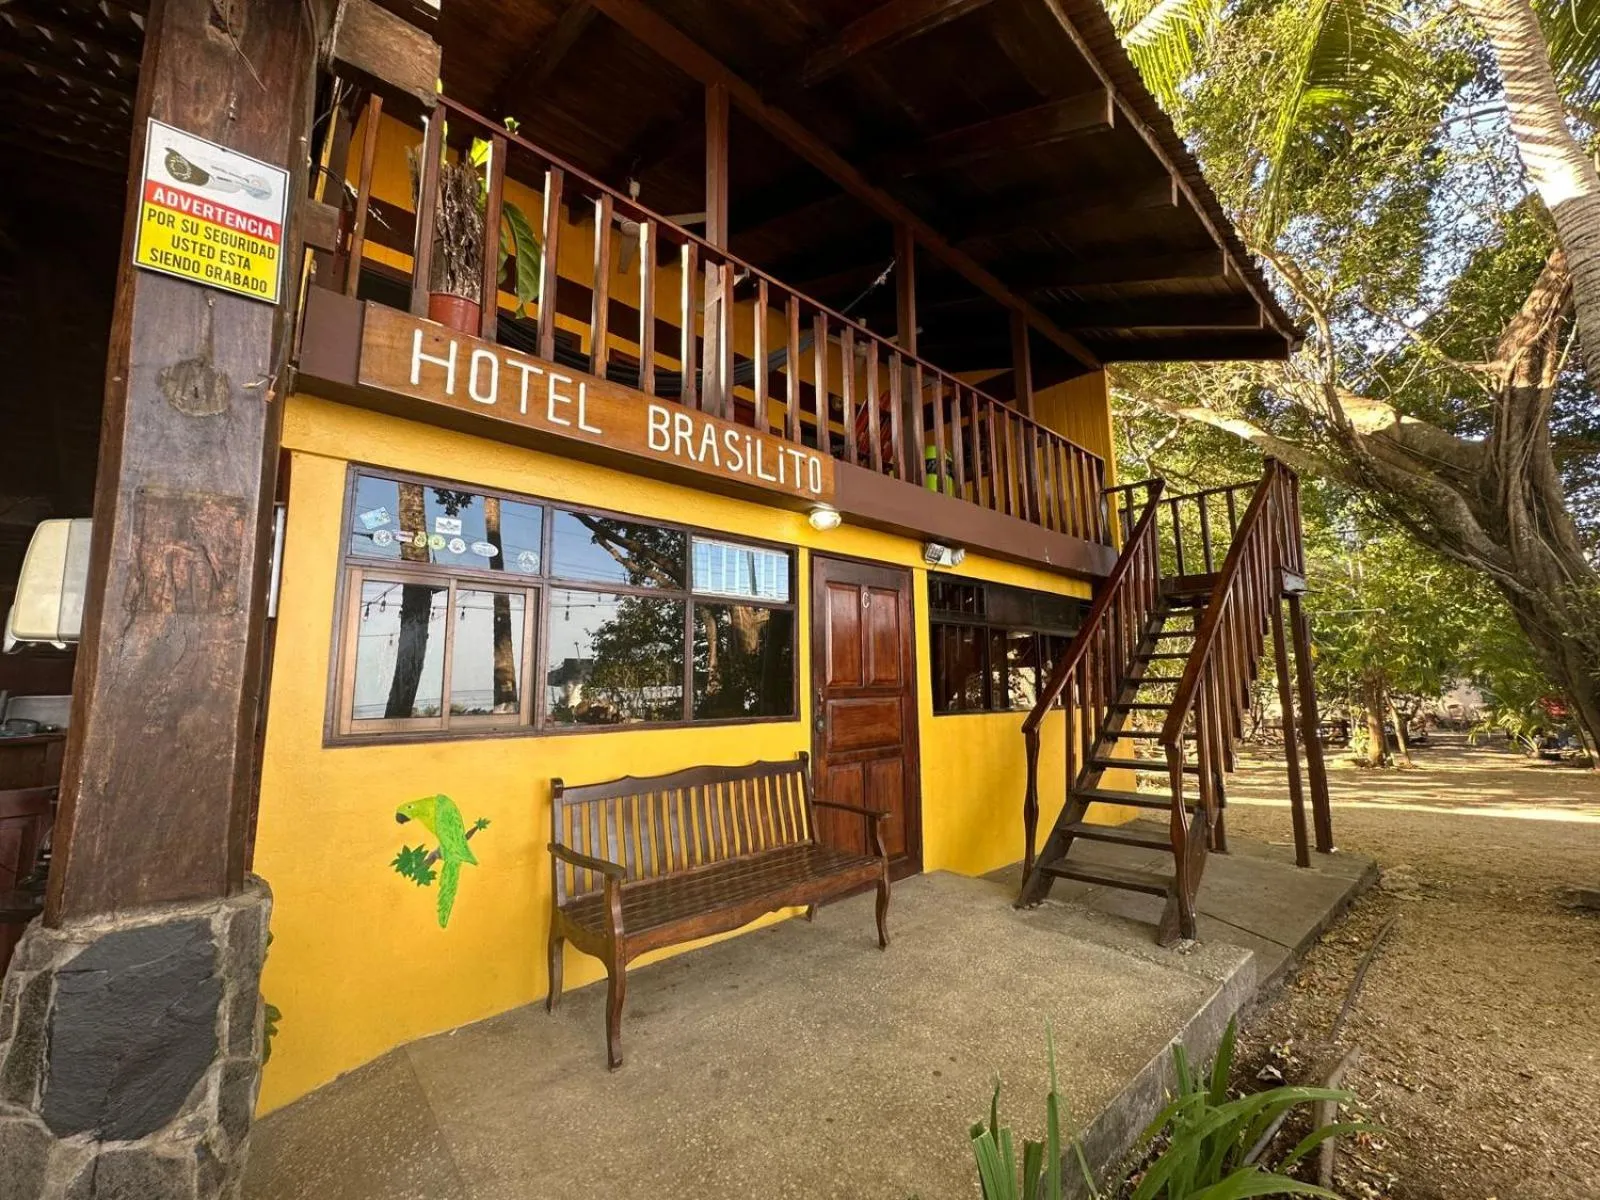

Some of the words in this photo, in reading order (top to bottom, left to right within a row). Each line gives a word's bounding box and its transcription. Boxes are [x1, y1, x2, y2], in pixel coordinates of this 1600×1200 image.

[147, 208, 176, 229] POR
[181, 219, 199, 236] SU
[203, 227, 275, 260] SEGURIDAD
[153, 187, 274, 240] ADVERTENCIA
[149, 247, 200, 274] SIENDO
[205, 264, 268, 293] GRABADO
[171, 234, 215, 260] USTED
[219, 250, 251, 271] ESTA
[409, 328, 603, 435] HOTEL
